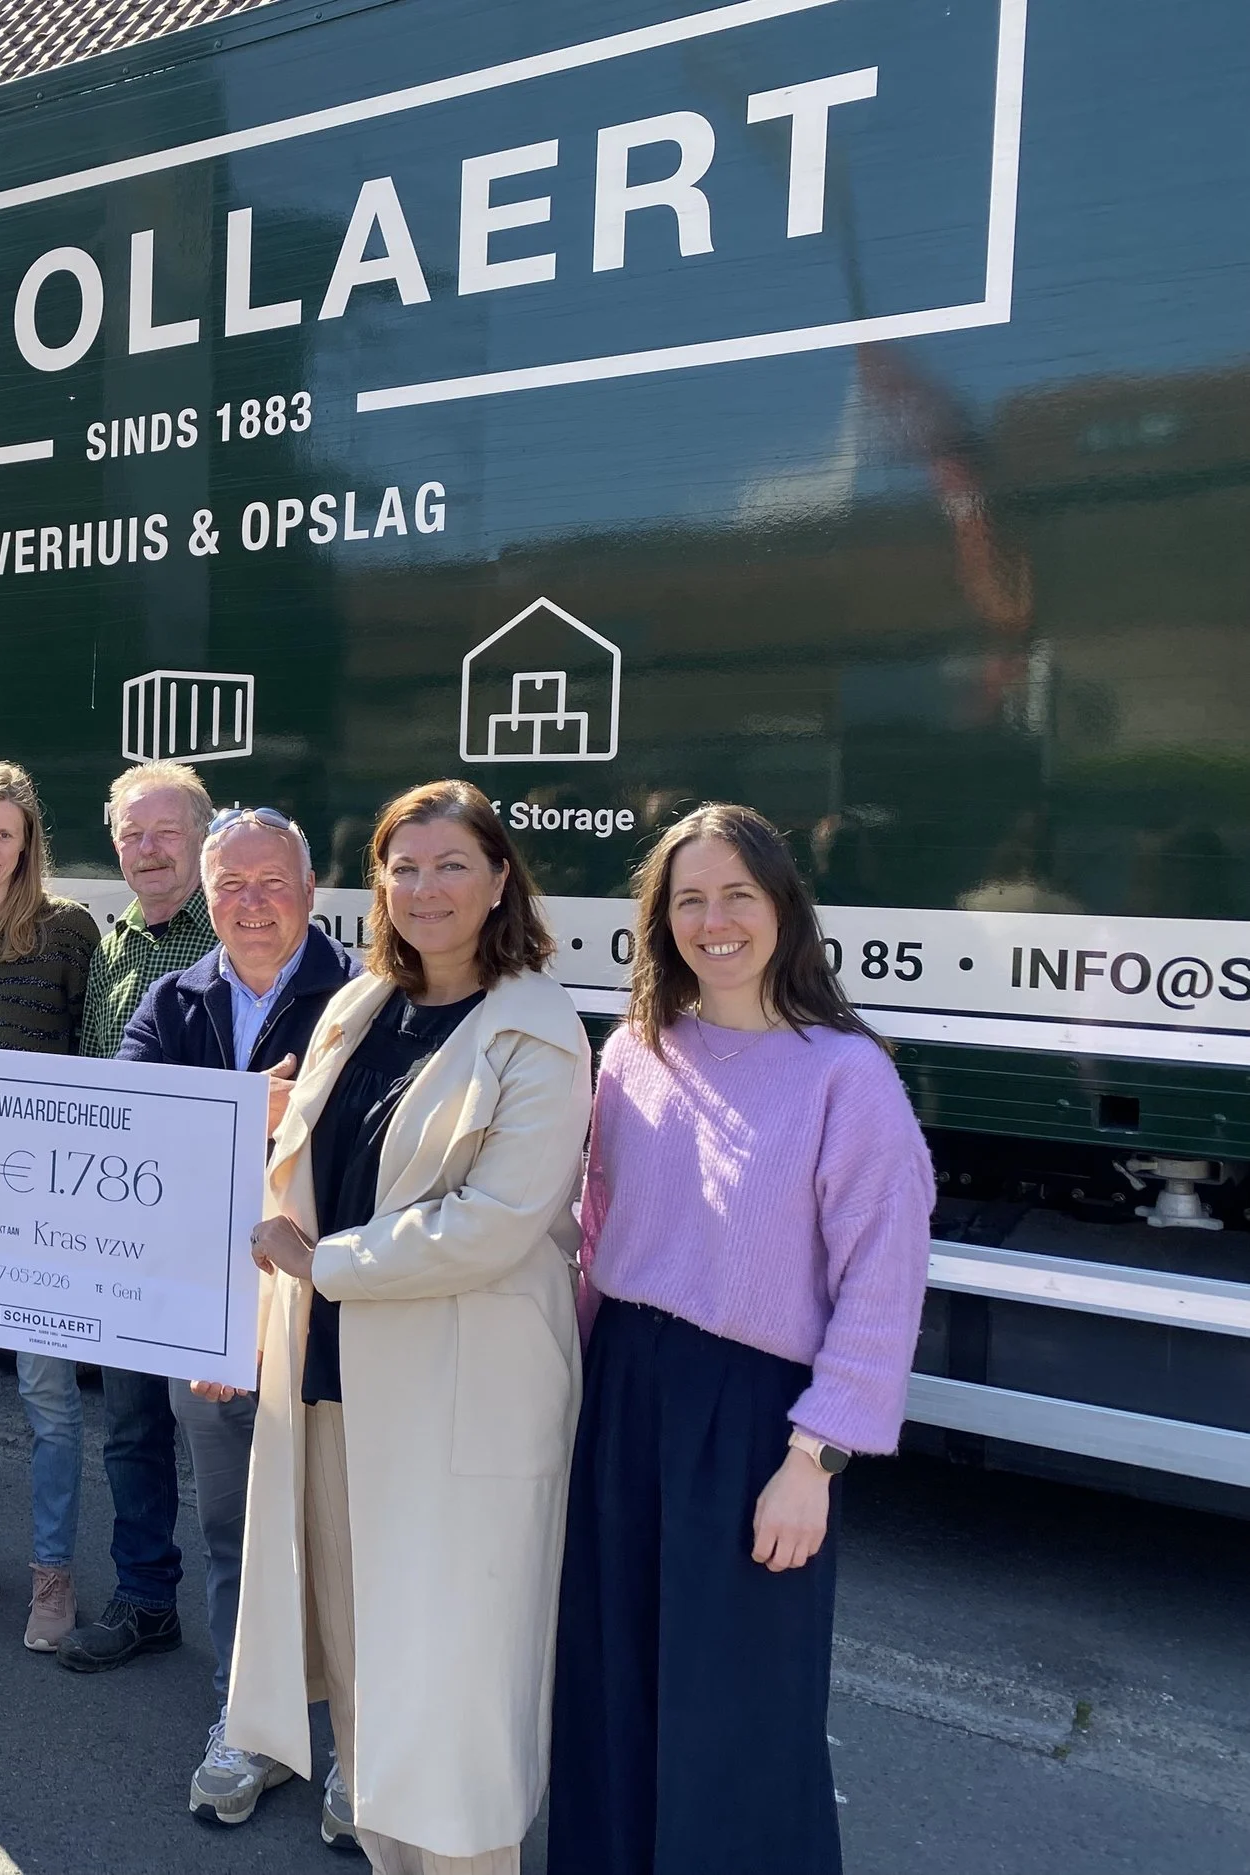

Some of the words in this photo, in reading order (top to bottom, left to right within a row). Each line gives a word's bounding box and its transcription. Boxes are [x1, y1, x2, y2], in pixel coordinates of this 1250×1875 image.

[85, 408, 199, 462] SINDS
[216, 391, 312, 443] 1883
[188, 509, 220, 556] &
[240, 480, 447, 553] OPSLAG
[508, 801, 634, 838] Storage
[861, 939, 923, 981] 85
[7, 1226, 20, 1237] AAN
[33, 1220, 88, 1252] Kras
[95, 1236, 146, 1260] vzw
[95, 1283, 103, 1294] TE
[111, 1282, 143, 1301] Gent
[3, 1309, 95, 1335] SCHOLLAERT
